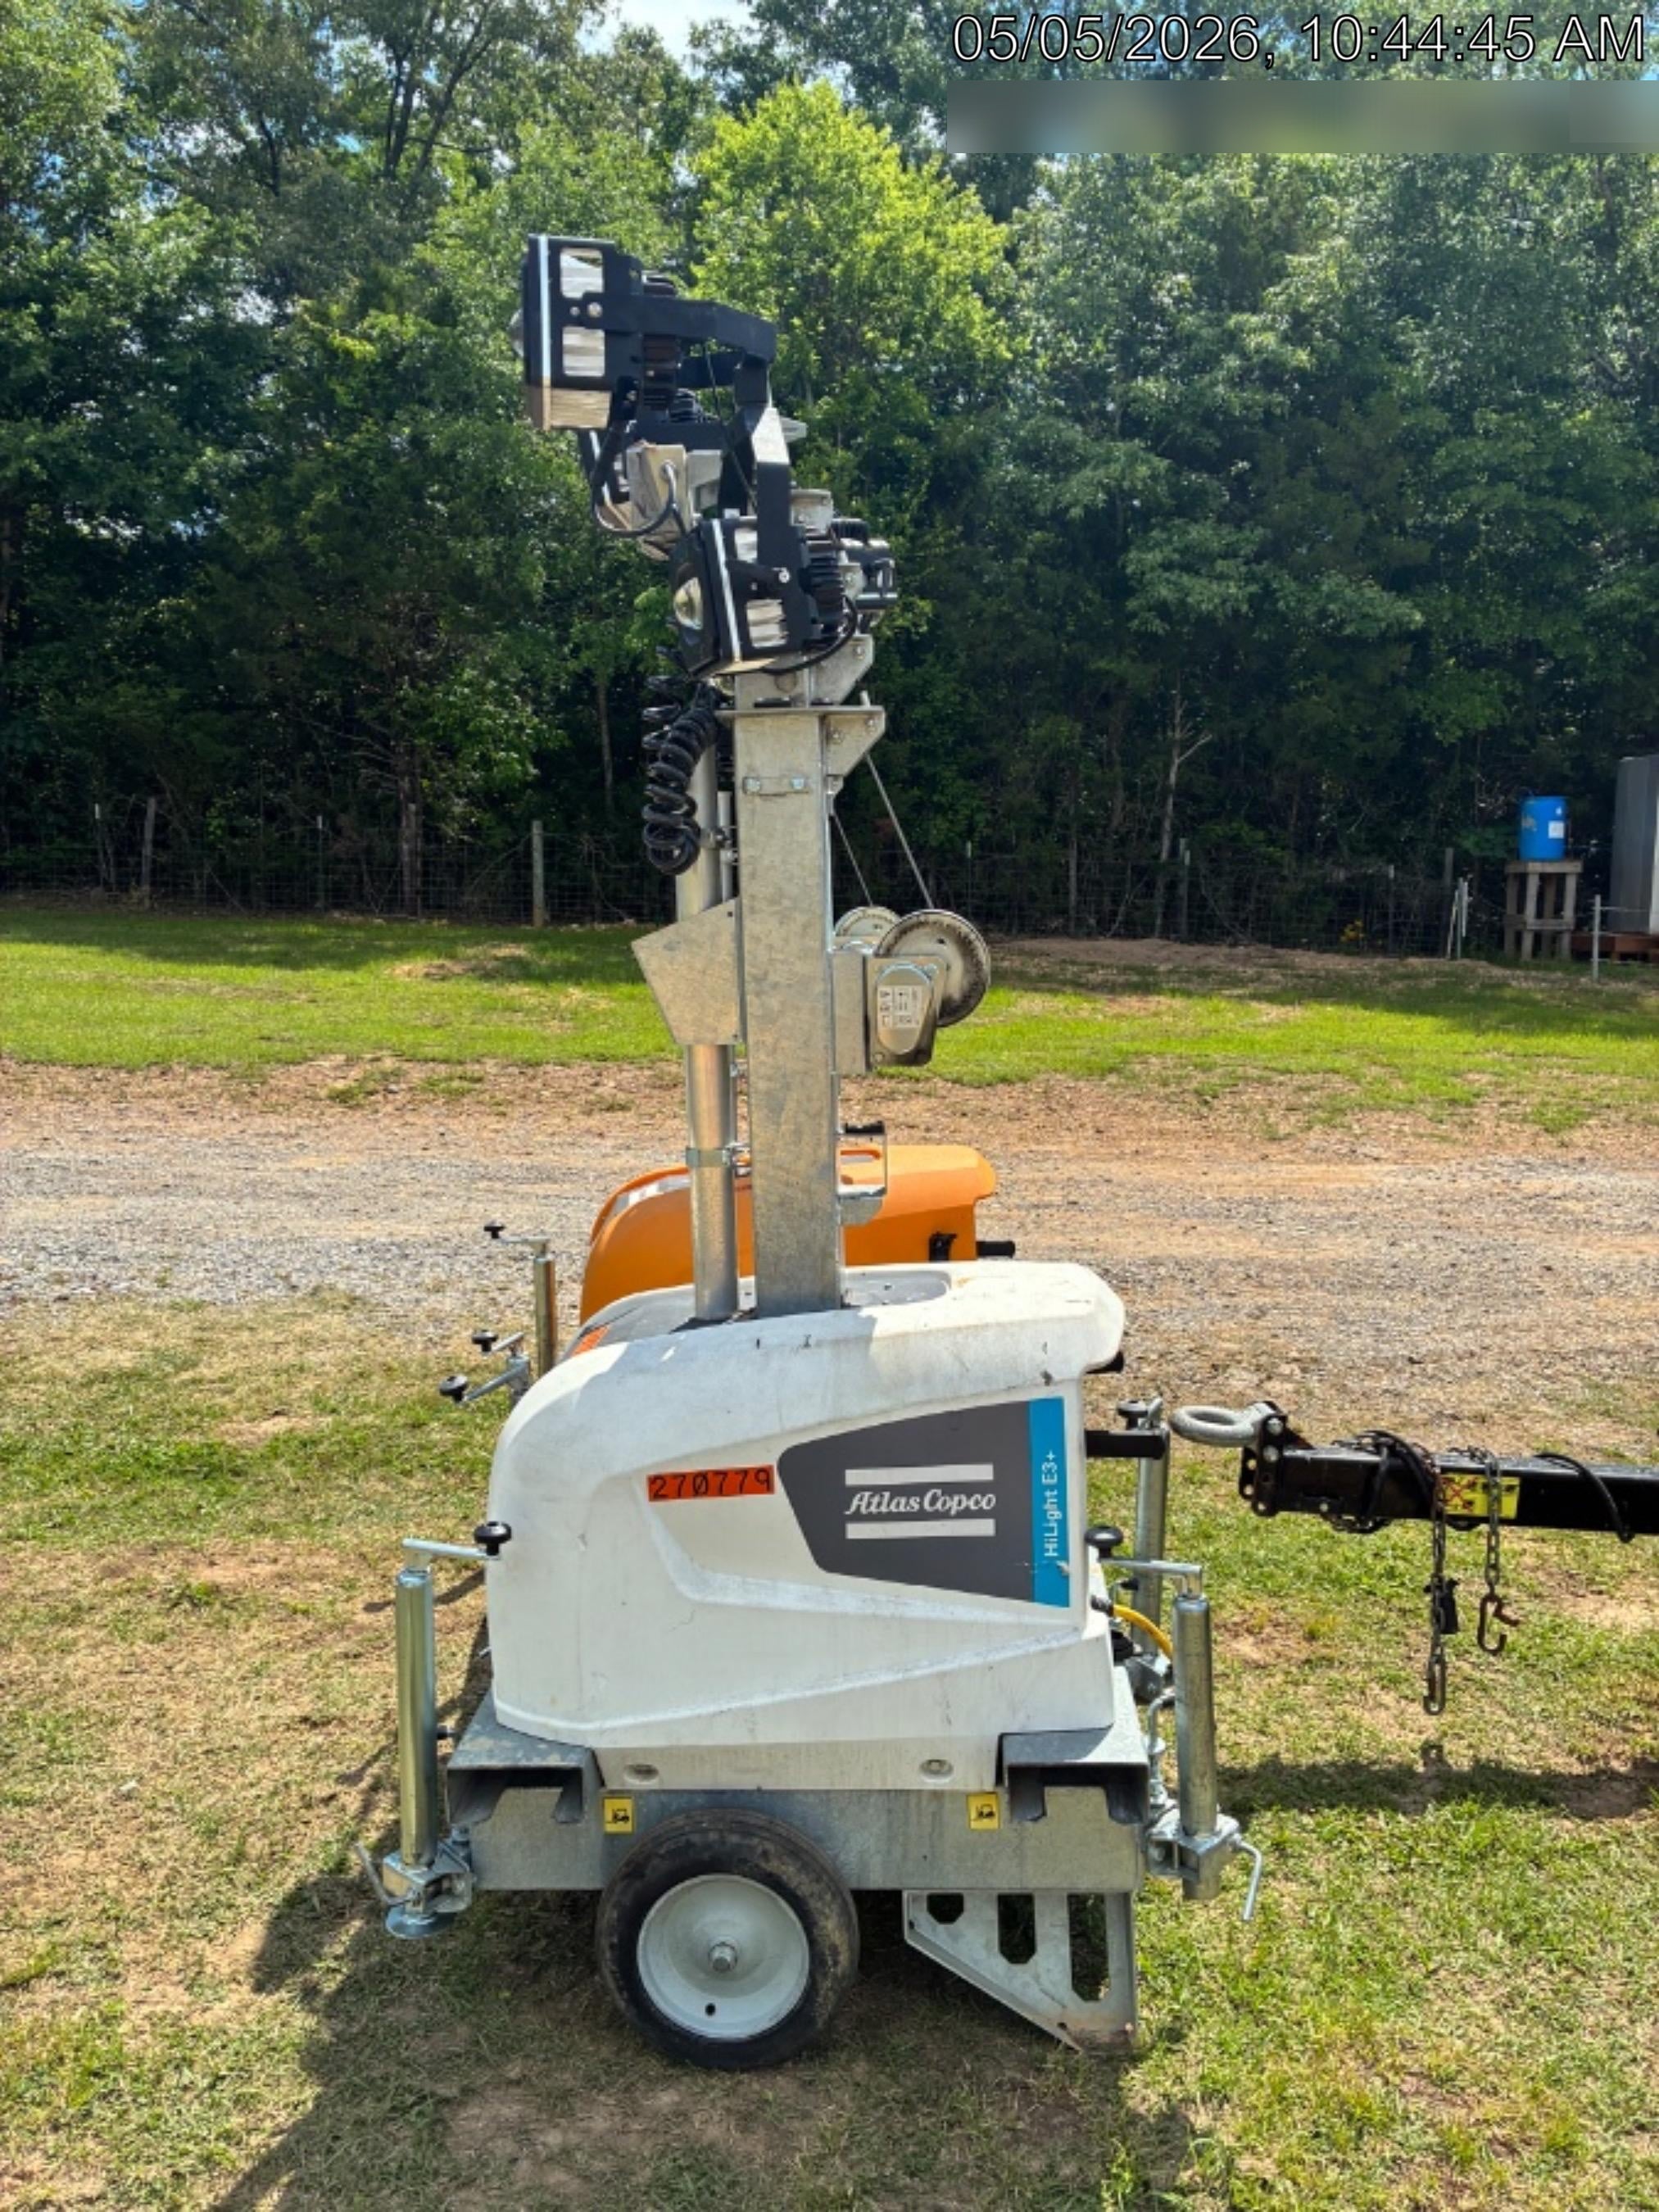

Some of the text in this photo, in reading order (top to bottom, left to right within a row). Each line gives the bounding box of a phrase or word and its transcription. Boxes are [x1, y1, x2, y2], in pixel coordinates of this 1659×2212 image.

[649, 1468, 771, 1498] 270779
[844, 1489, 996, 1516] Atlas Copco
[1041, 1450, 1063, 1557] HiLight E3+
